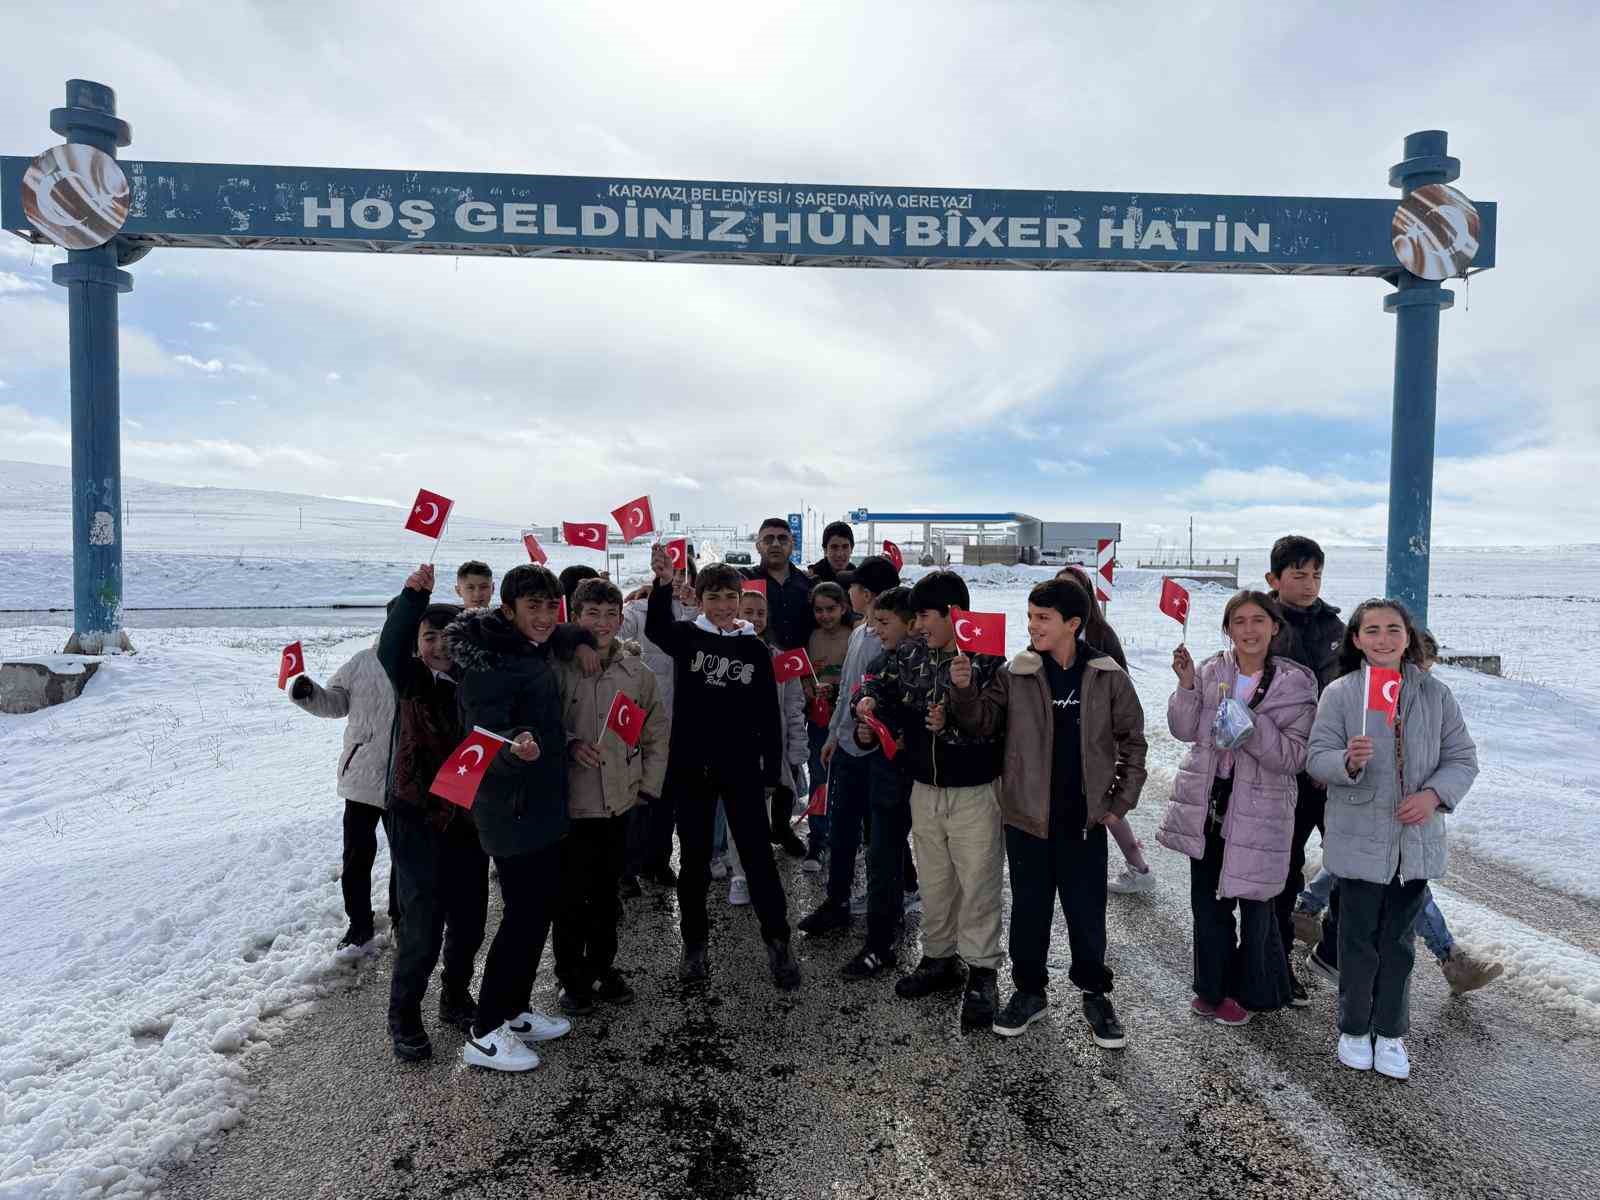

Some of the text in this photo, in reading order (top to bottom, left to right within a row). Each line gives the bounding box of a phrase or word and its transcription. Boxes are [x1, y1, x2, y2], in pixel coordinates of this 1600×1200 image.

[608, 184, 687, 200] KARAYAZI
[691, 187, 783, 204] BELEDİYESİ
[303, 196, 1271, 253] HOŞ GELDİNİZ HÛN BÎXER HATİN
